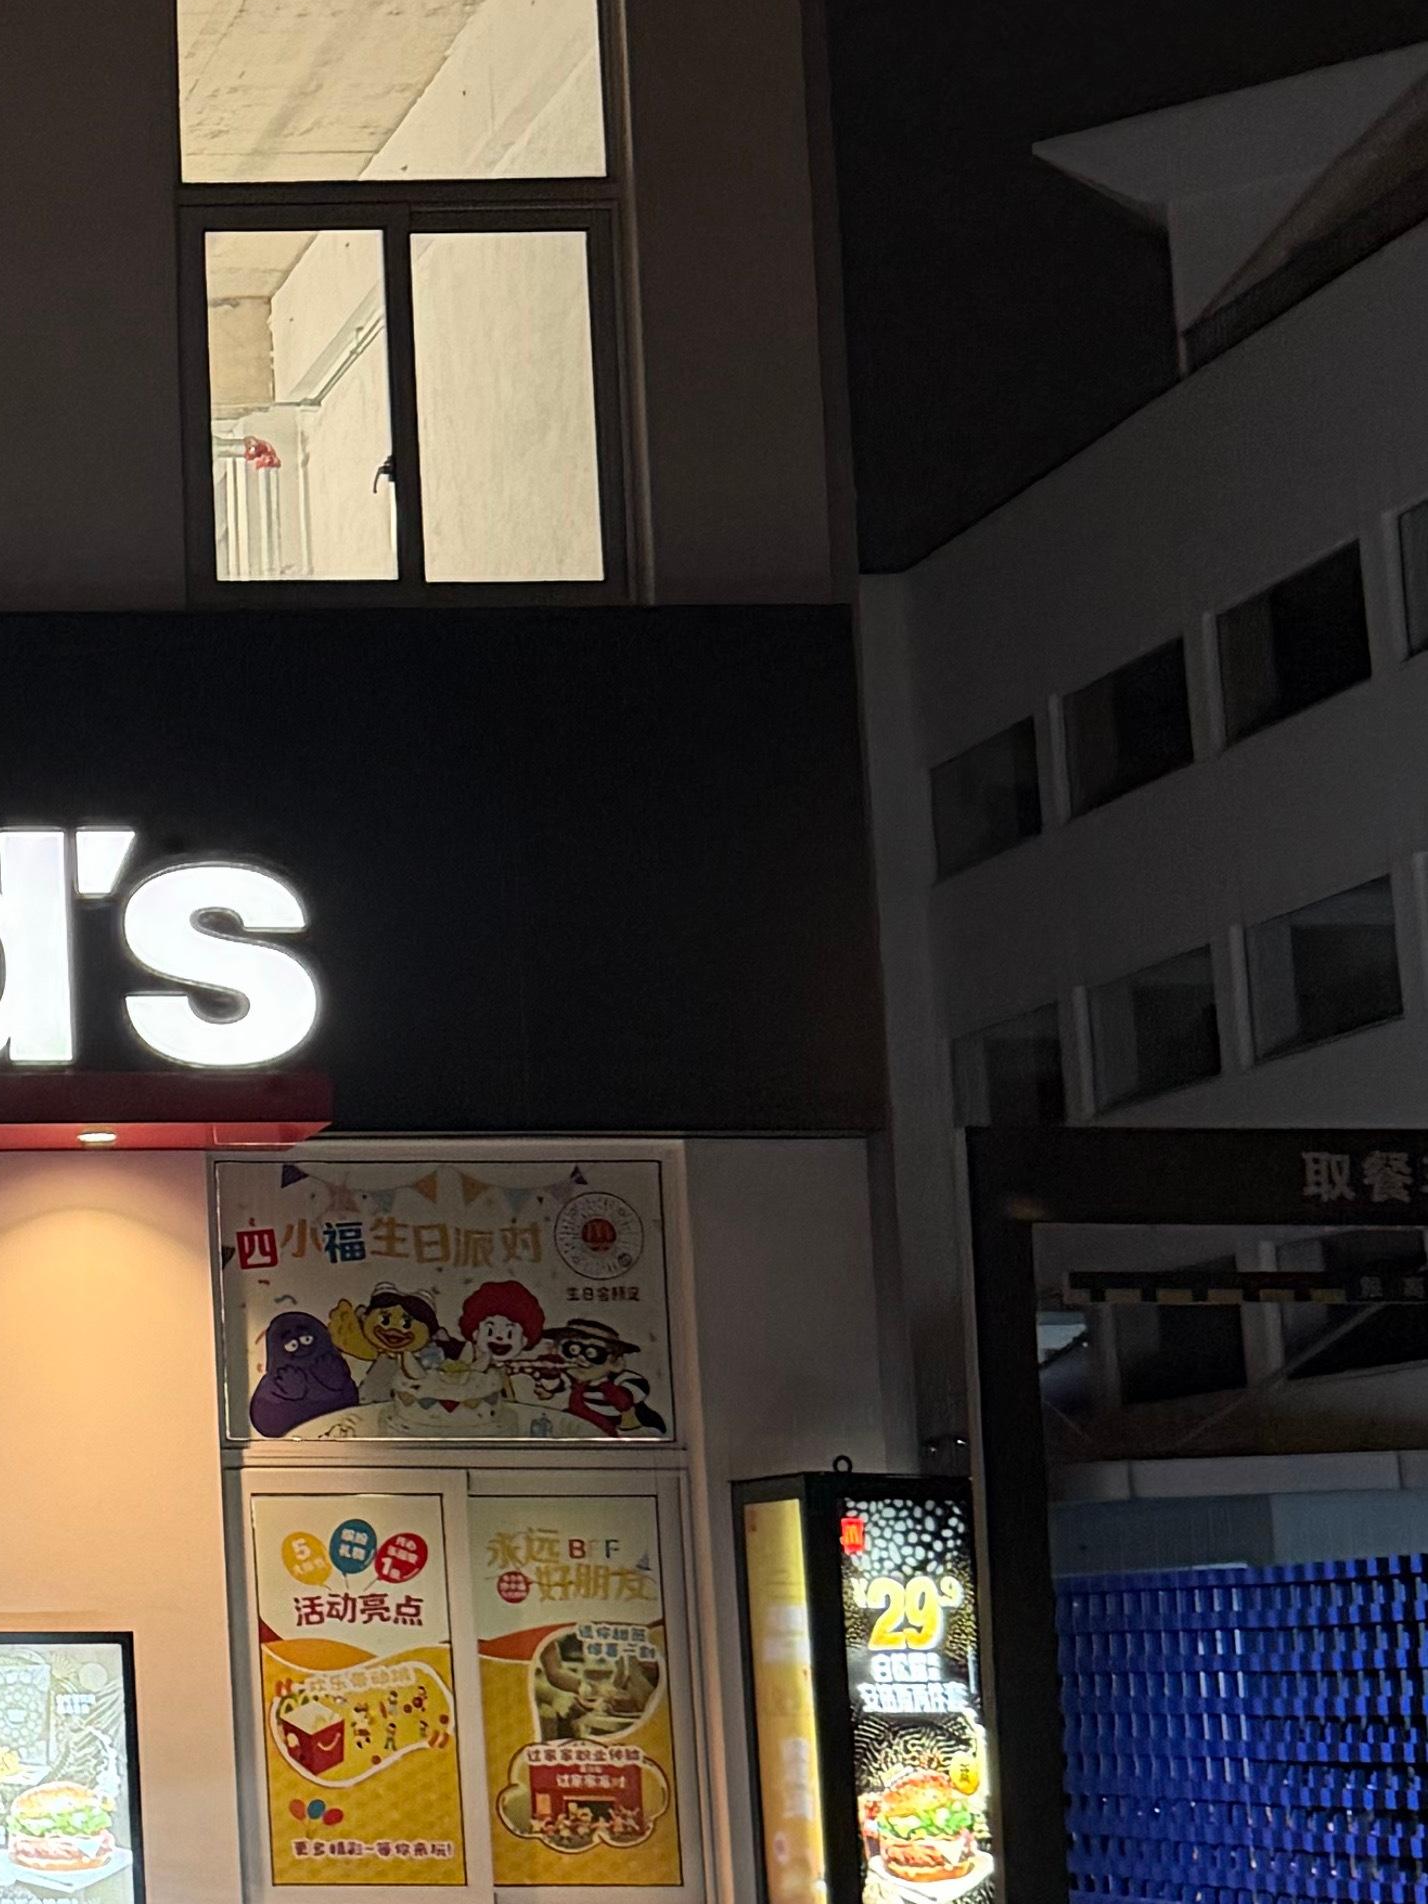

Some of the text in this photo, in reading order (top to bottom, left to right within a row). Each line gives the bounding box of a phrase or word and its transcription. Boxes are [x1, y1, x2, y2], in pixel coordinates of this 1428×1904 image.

[1300, 1150, 1428, 1203] 取餐
[236, 1217, 543, 1270] 四小福生日派对
[486, 1528, 561, 1569] 永远
[535, 1563, 658, 1602] 好朋友
[293, 1592, 424, 1627] 活动亮点
